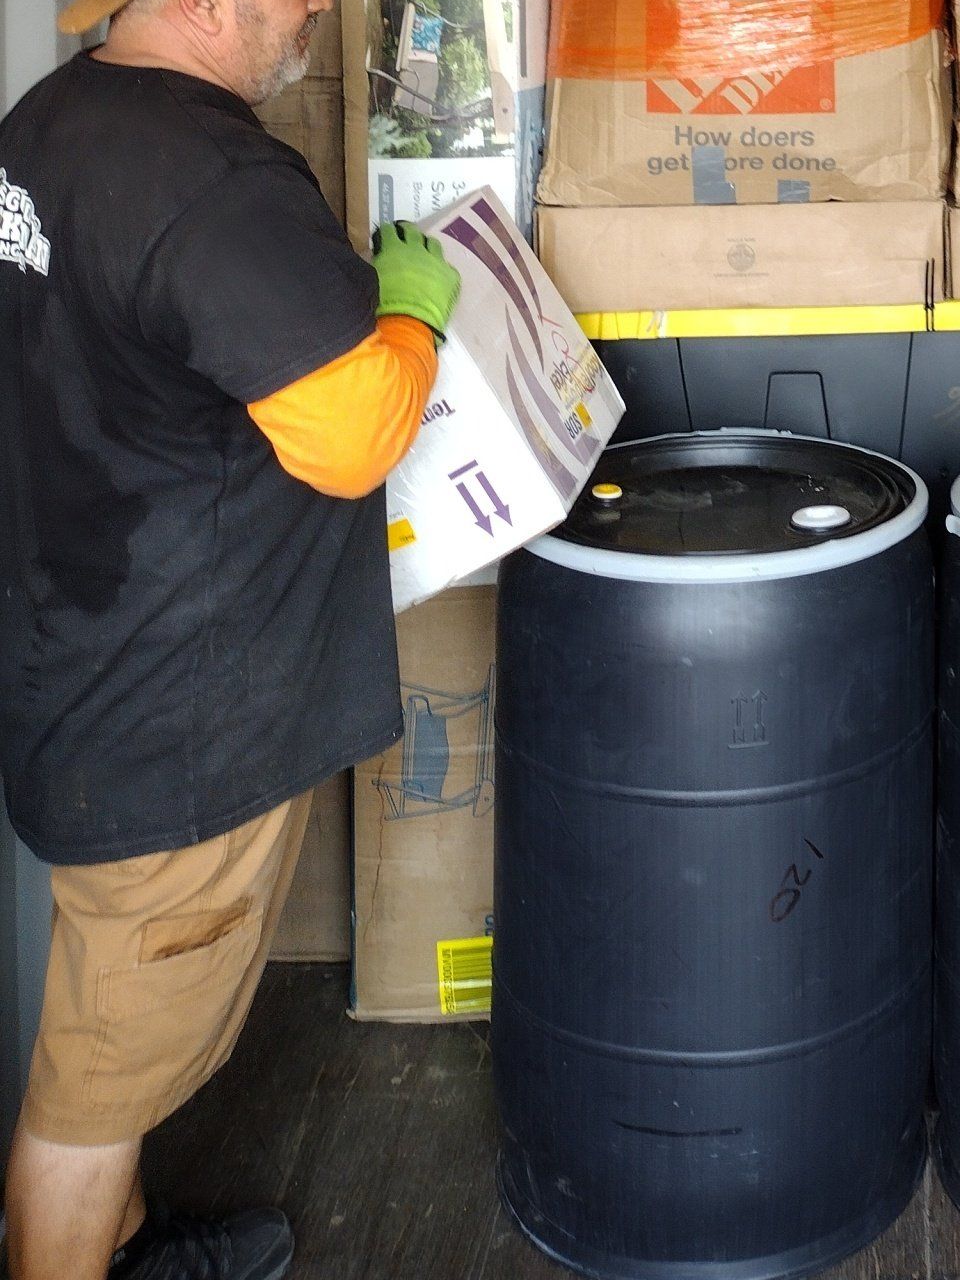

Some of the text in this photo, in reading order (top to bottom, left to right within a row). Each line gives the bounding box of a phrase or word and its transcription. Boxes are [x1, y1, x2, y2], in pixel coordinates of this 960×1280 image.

[674, 125, 815, 147] How doers
[647, 153, 837, 176] get ore done
[768, 837, 825, 922] 120
